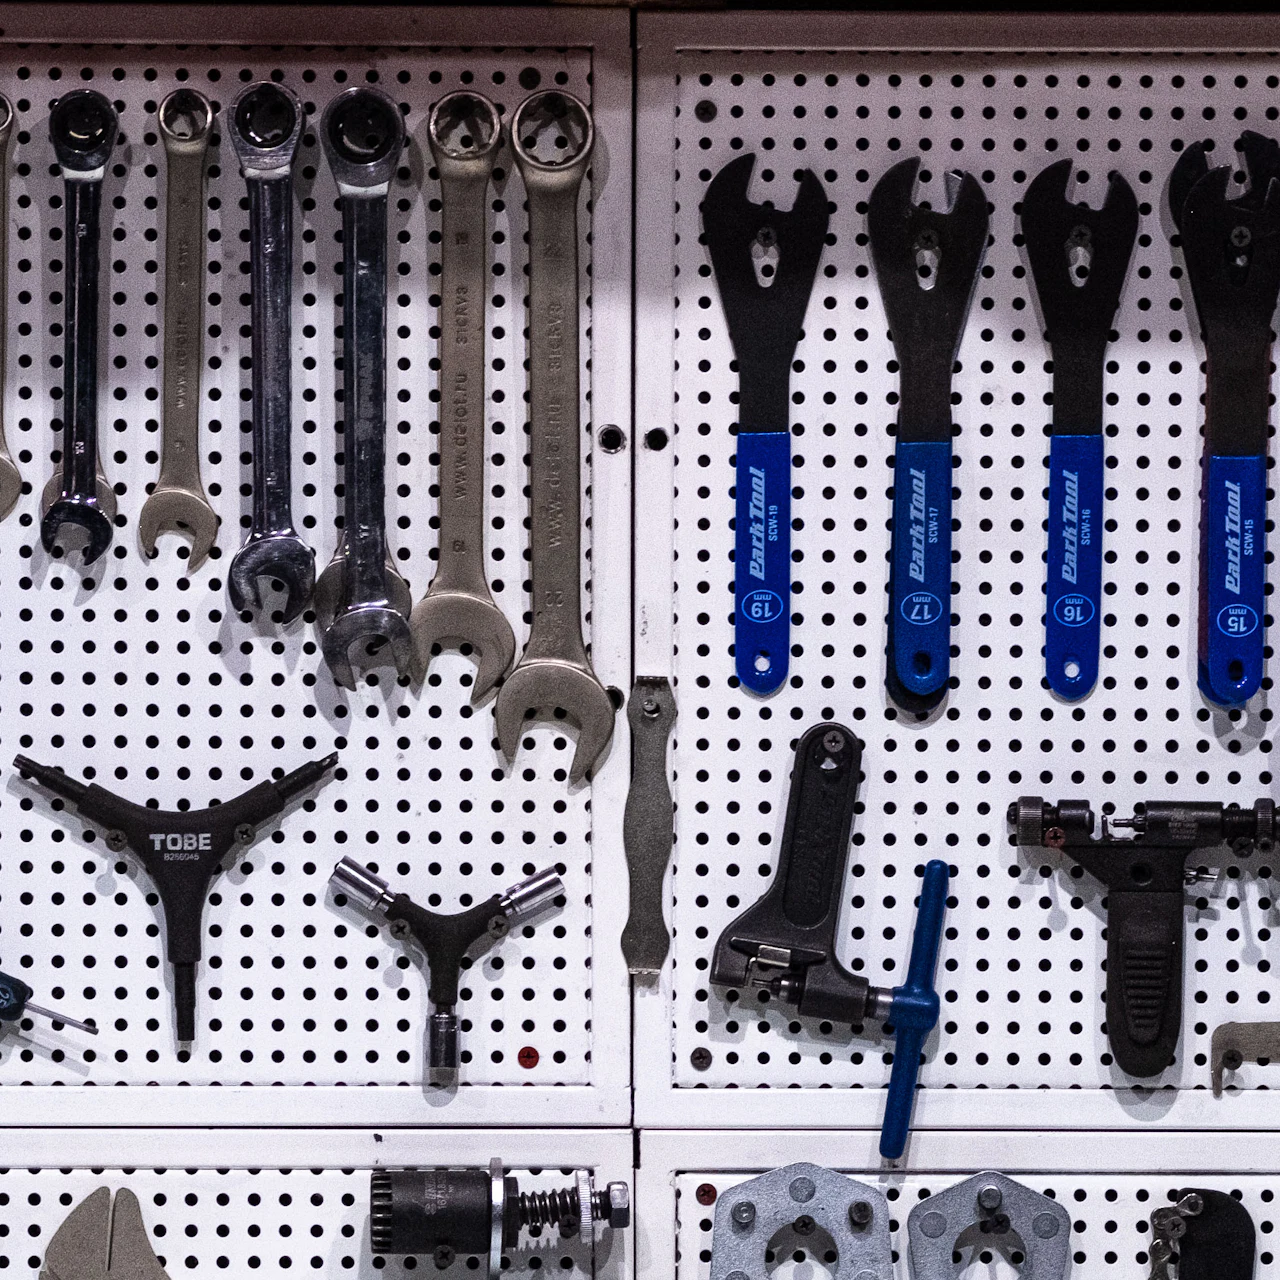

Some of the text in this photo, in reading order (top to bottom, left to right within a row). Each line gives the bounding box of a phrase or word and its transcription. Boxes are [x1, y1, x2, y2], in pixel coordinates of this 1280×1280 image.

[749, 466, 765, 581] Park Tool
[768, 505, 778, 542] SCW-19
[909, 468, 926, 583] Park Tool
[928, 507, 939, 544] SCW-17
[1061, 469, 1079, 585] Park Tool
[1081, 508, 1091, 546] SCW-16
[1225, 480, 1241, 595] Park Tool
[1244, 519, 1254, 556] SCW-15
[751, 602, 773, 618] 19
[910, 604, 932, 620] 17
[1063, 606, 1085, 622] 16
[1227, 616, 1248, 633] 15
[1228, 608, 1247, 616] mm
[149, 833, 212, 851] TOBE
